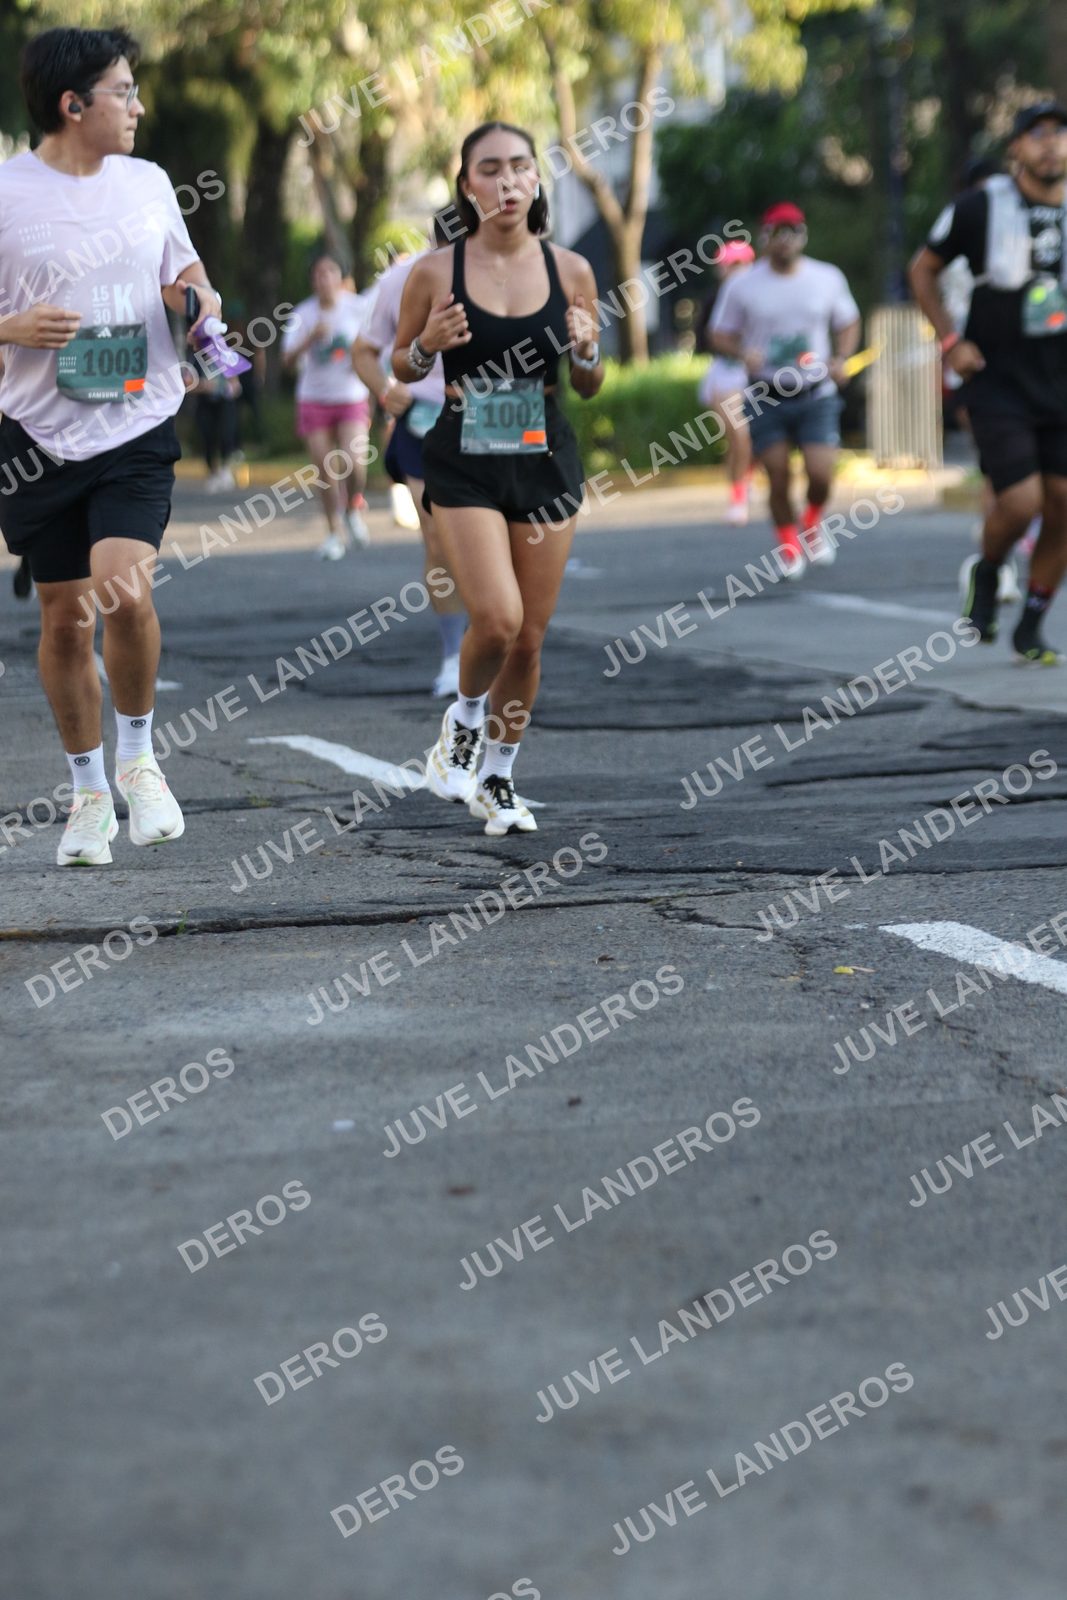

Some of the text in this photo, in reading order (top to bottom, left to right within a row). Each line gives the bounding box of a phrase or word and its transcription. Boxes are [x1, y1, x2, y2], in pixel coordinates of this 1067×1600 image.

[113, 282, 136, 323] K
[82, 347, 145, 377] 1003
[482, 400, 545, 429] 1002
